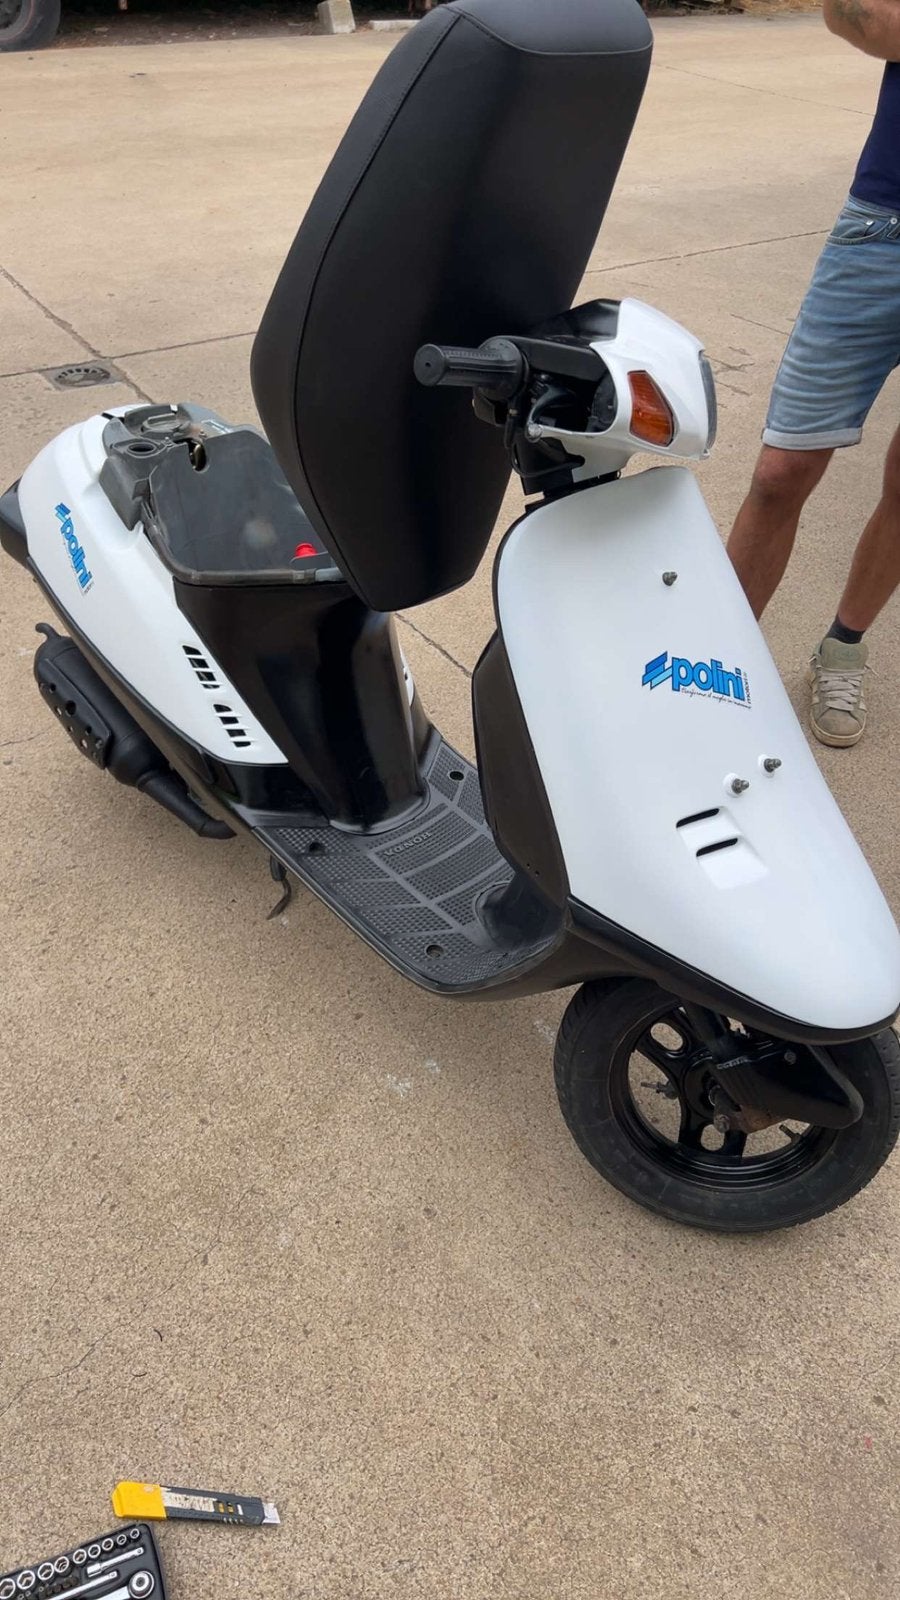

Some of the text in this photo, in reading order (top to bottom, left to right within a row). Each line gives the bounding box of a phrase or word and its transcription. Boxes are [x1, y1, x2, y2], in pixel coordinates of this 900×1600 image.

[60, 516, 93, 589] polini
[671, 656, 746, 702] polini
[383, 832, 432, 856] HONDA
